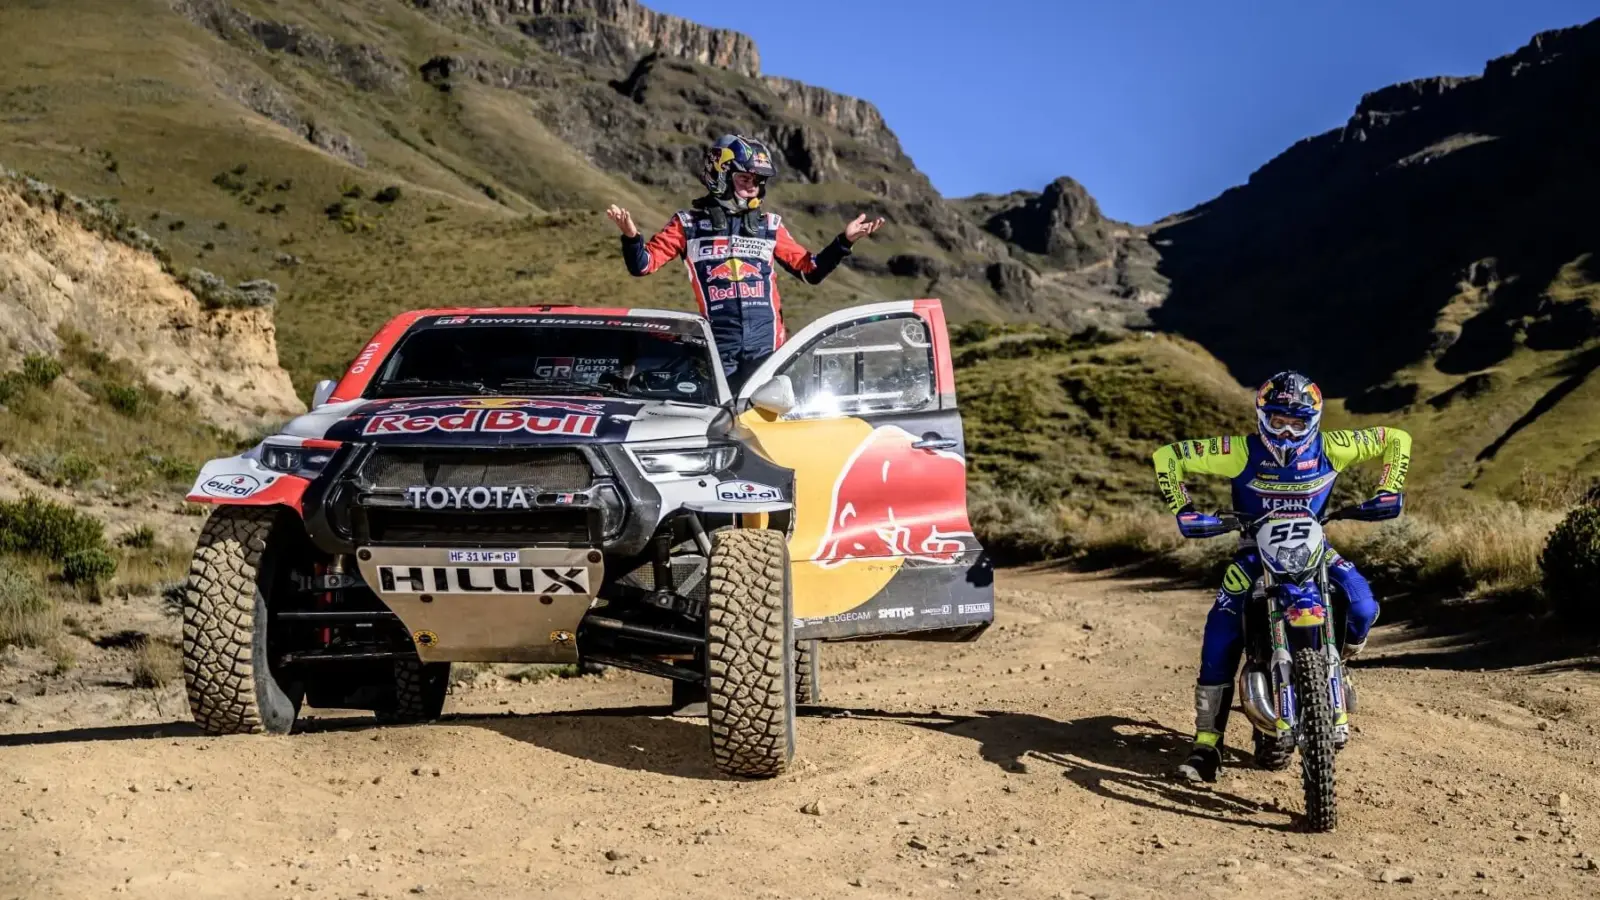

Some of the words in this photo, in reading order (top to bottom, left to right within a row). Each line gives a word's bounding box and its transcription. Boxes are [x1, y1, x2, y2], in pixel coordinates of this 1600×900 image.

[708, 281, 738, 301] Red
[739, 281, 764, 298] Bull
[434, 316, 469, 326] GR
[607, 320, 671, 330] Racing
[351, 342, 381, 374] KINTO
[535, 365, 572, 379] GR
[362, 409, 484, 436] Red
[480, 410, 602, 437] Bull
[207, 479, 253, 496] eurol
[721, 489, 777, 500] eurol
[409, 486, 530, 510] TOYOTA
[1262, 498, 1313, 511] KENNY
[1268, 522, 1313, 546] 55
[451, 552, 464, 561] HF
[467, 552, 478, 562] 31
[482, 552, 495, 562] WF
[503, 552, 517, 562] GP
[379, 566, 588, 594] HILUX
[828, 612, 871, 623] EDGECAM
